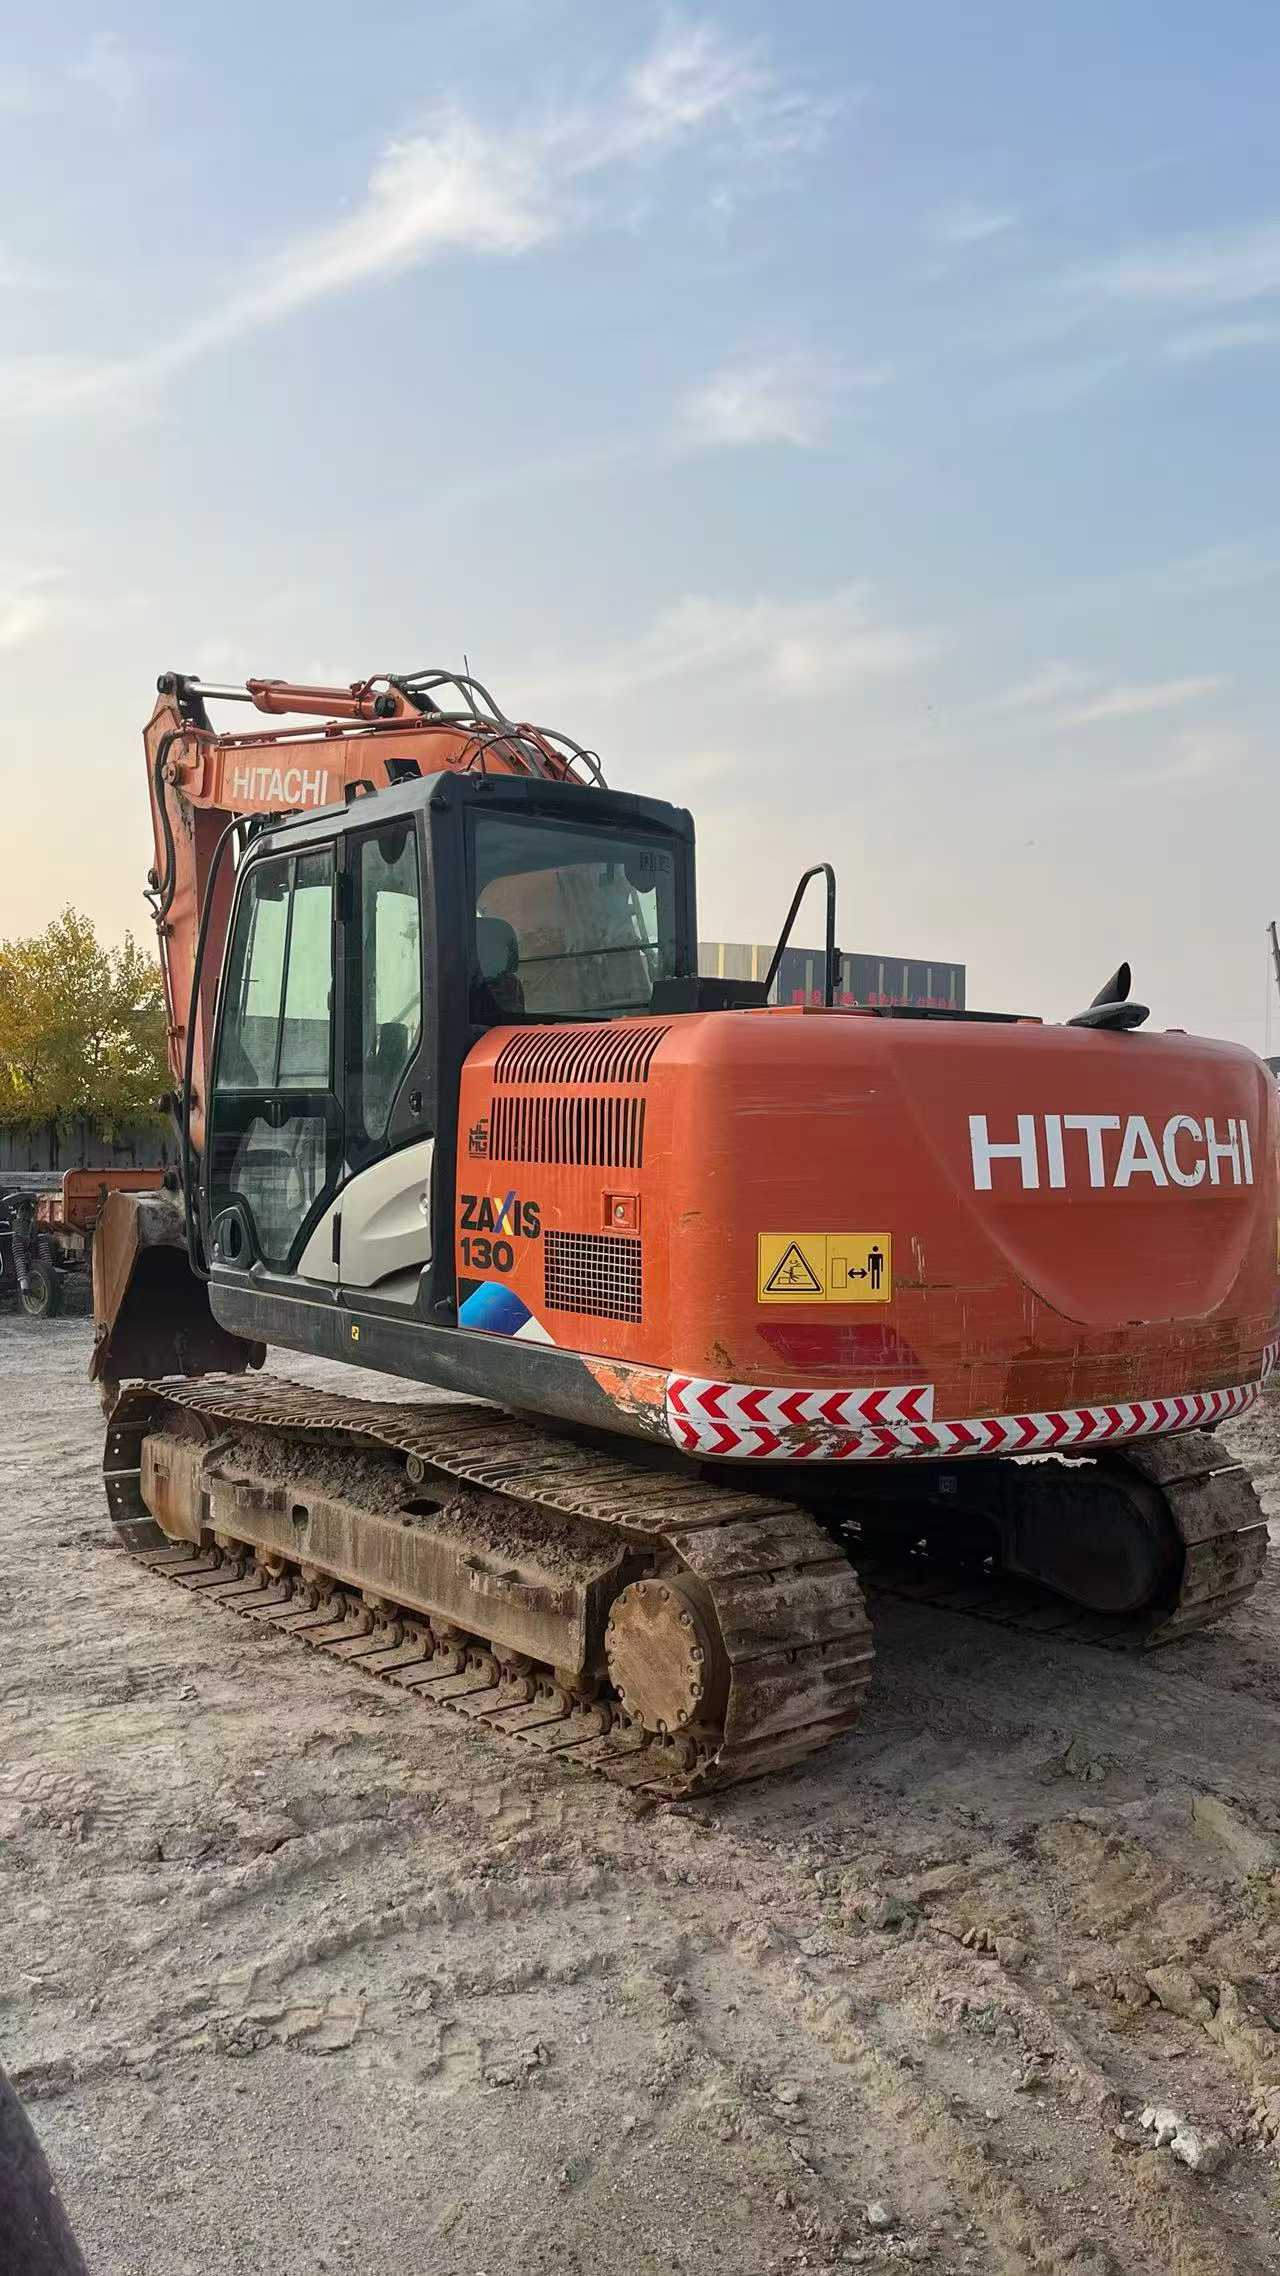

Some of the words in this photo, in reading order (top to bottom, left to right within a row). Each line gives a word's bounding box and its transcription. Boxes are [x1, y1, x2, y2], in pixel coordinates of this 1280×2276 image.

[232, 766, 328, 805] HITACHI
[968, 1114, 1254, 1190] HITACHI
[460, 1190, 541, 1239] ZAXIS
[460, 1236, 514, 1272] 130
